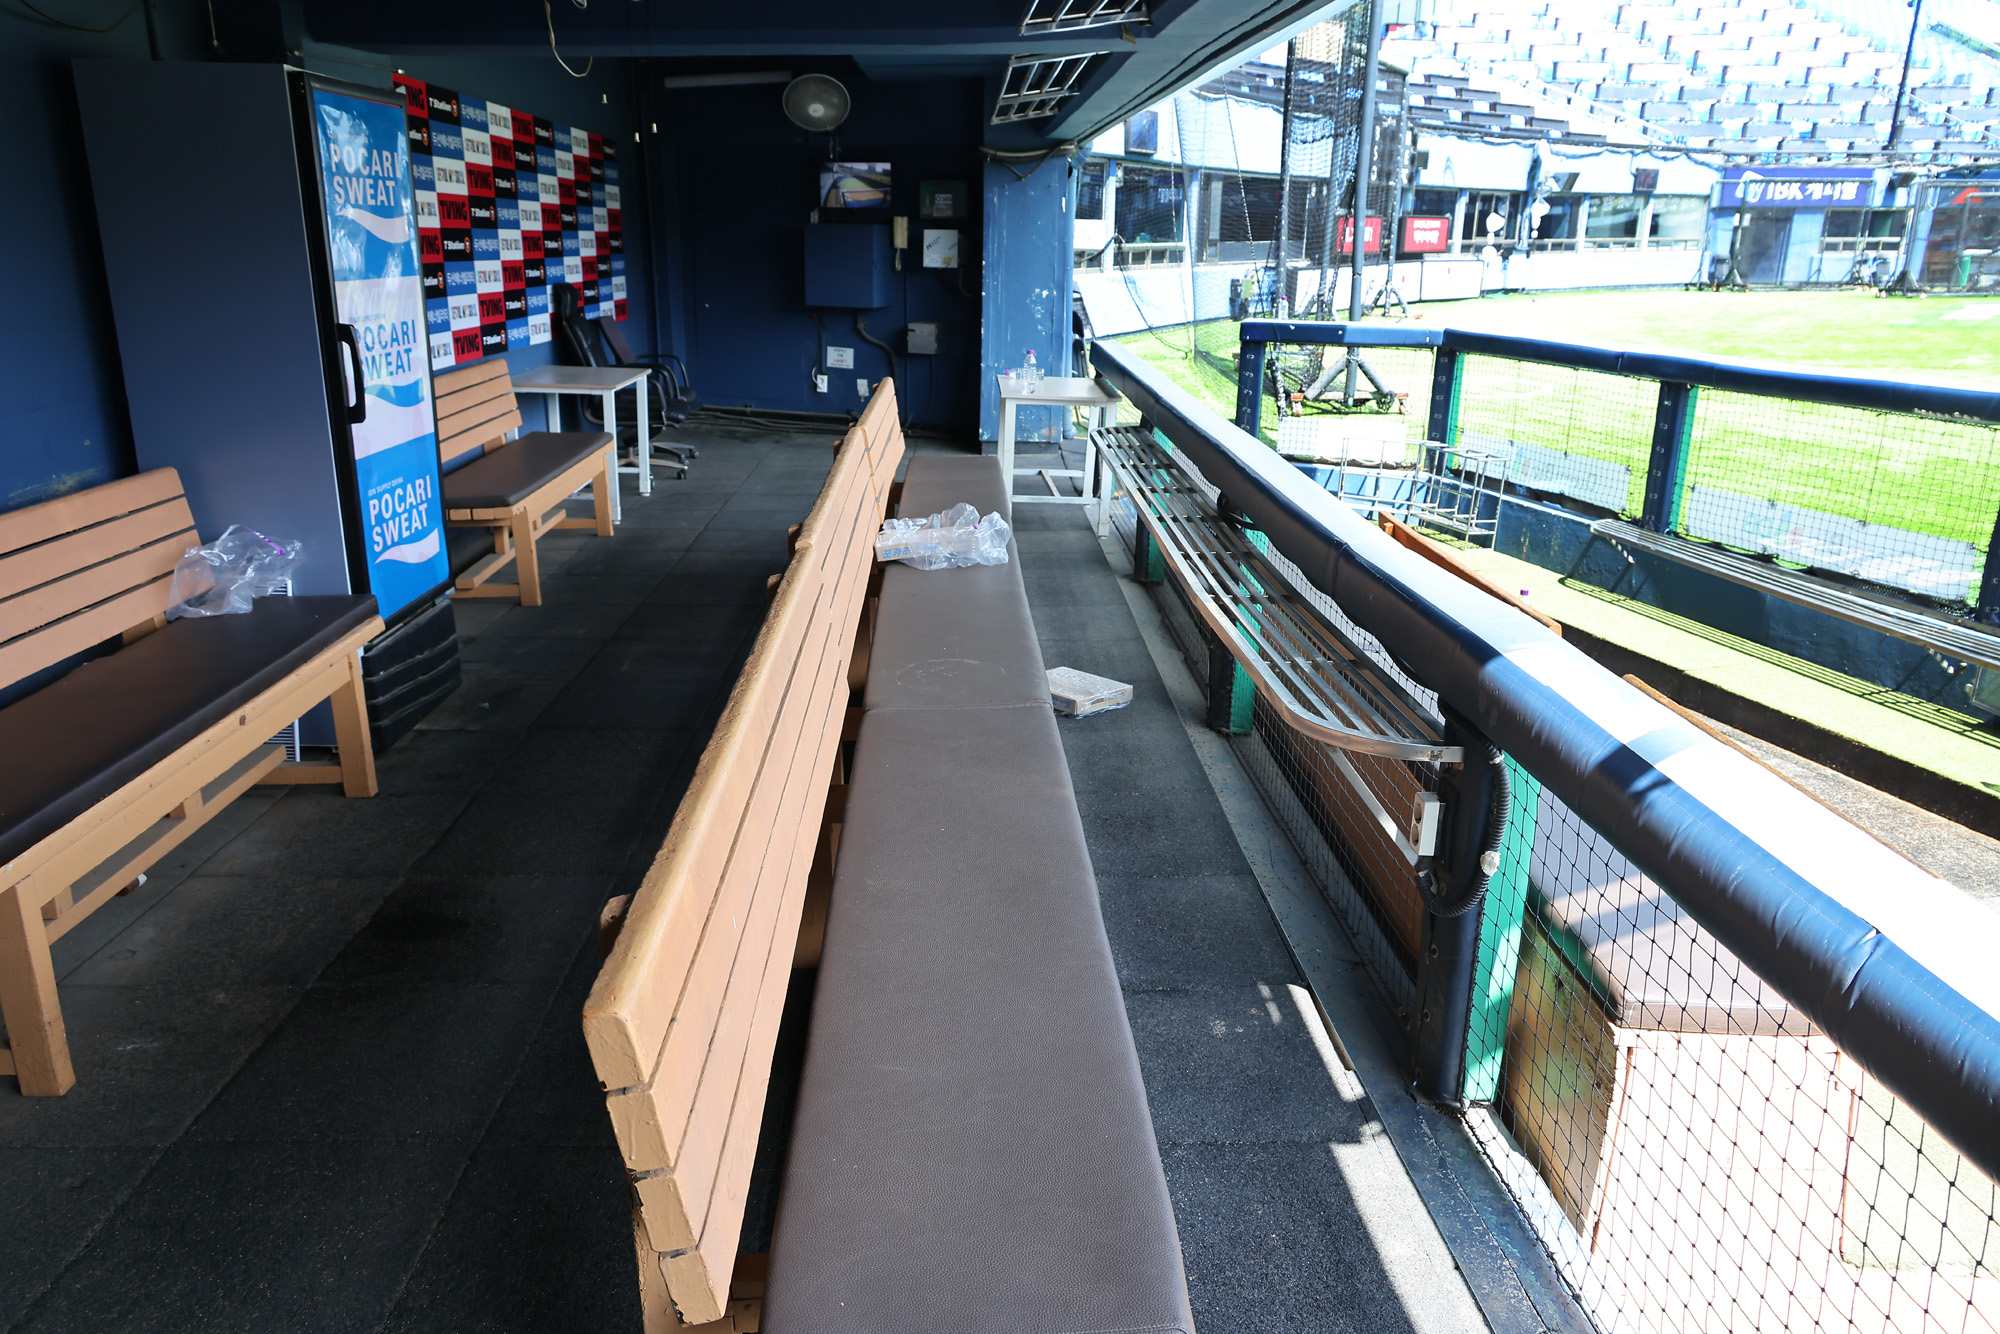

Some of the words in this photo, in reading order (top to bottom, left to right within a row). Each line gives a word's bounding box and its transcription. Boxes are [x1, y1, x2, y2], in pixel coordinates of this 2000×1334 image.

[329, 143, 400, 178] POCARI
[466, 169, 491, 189] TVING
[333, 176, 396, 206] SWEAT
[439, 200, 467, 220] TVING
[502, 266, 523, 283] TVING
[479, 298, 502, 317] TVING
[454, 333, 480, 356] TVING
[361, 348, 412, 380] WEAT
[376, 480, 392, 493] SUPPLY
[391, 476, 404, 487] DRINK
[369, 475, 432, 526] POCARI
[372, 502, 428, 553] SWEAT
[883, 546, 911, 559] 포카리
